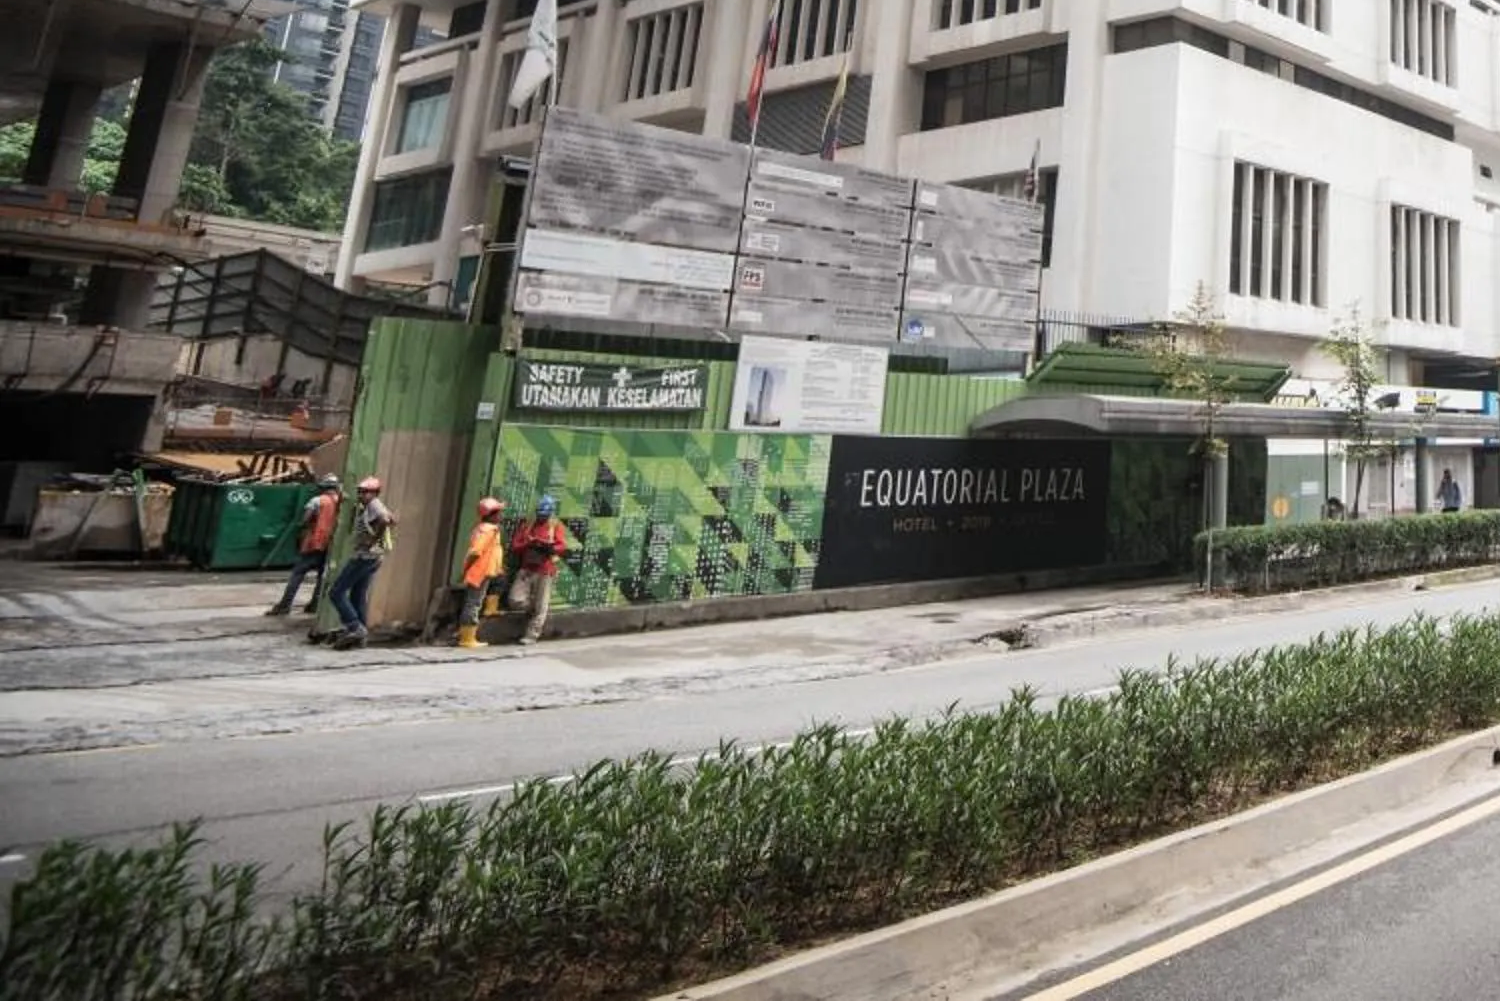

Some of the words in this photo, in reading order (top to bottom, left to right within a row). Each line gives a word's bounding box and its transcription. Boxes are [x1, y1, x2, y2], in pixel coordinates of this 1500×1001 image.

[528, 363, 585, 384] SAFETY
[661, 368, 698, 386] FIRST
[521, 383, 600, 408] UTAMAKAN
[607, 386, 702, 409] KESELAMATAN
[860, 467, 1011, 507] EQUATORIAL
[1019, 467, 1085, 502] PLAZA
[893, 516, 939, 532] HOTEL
